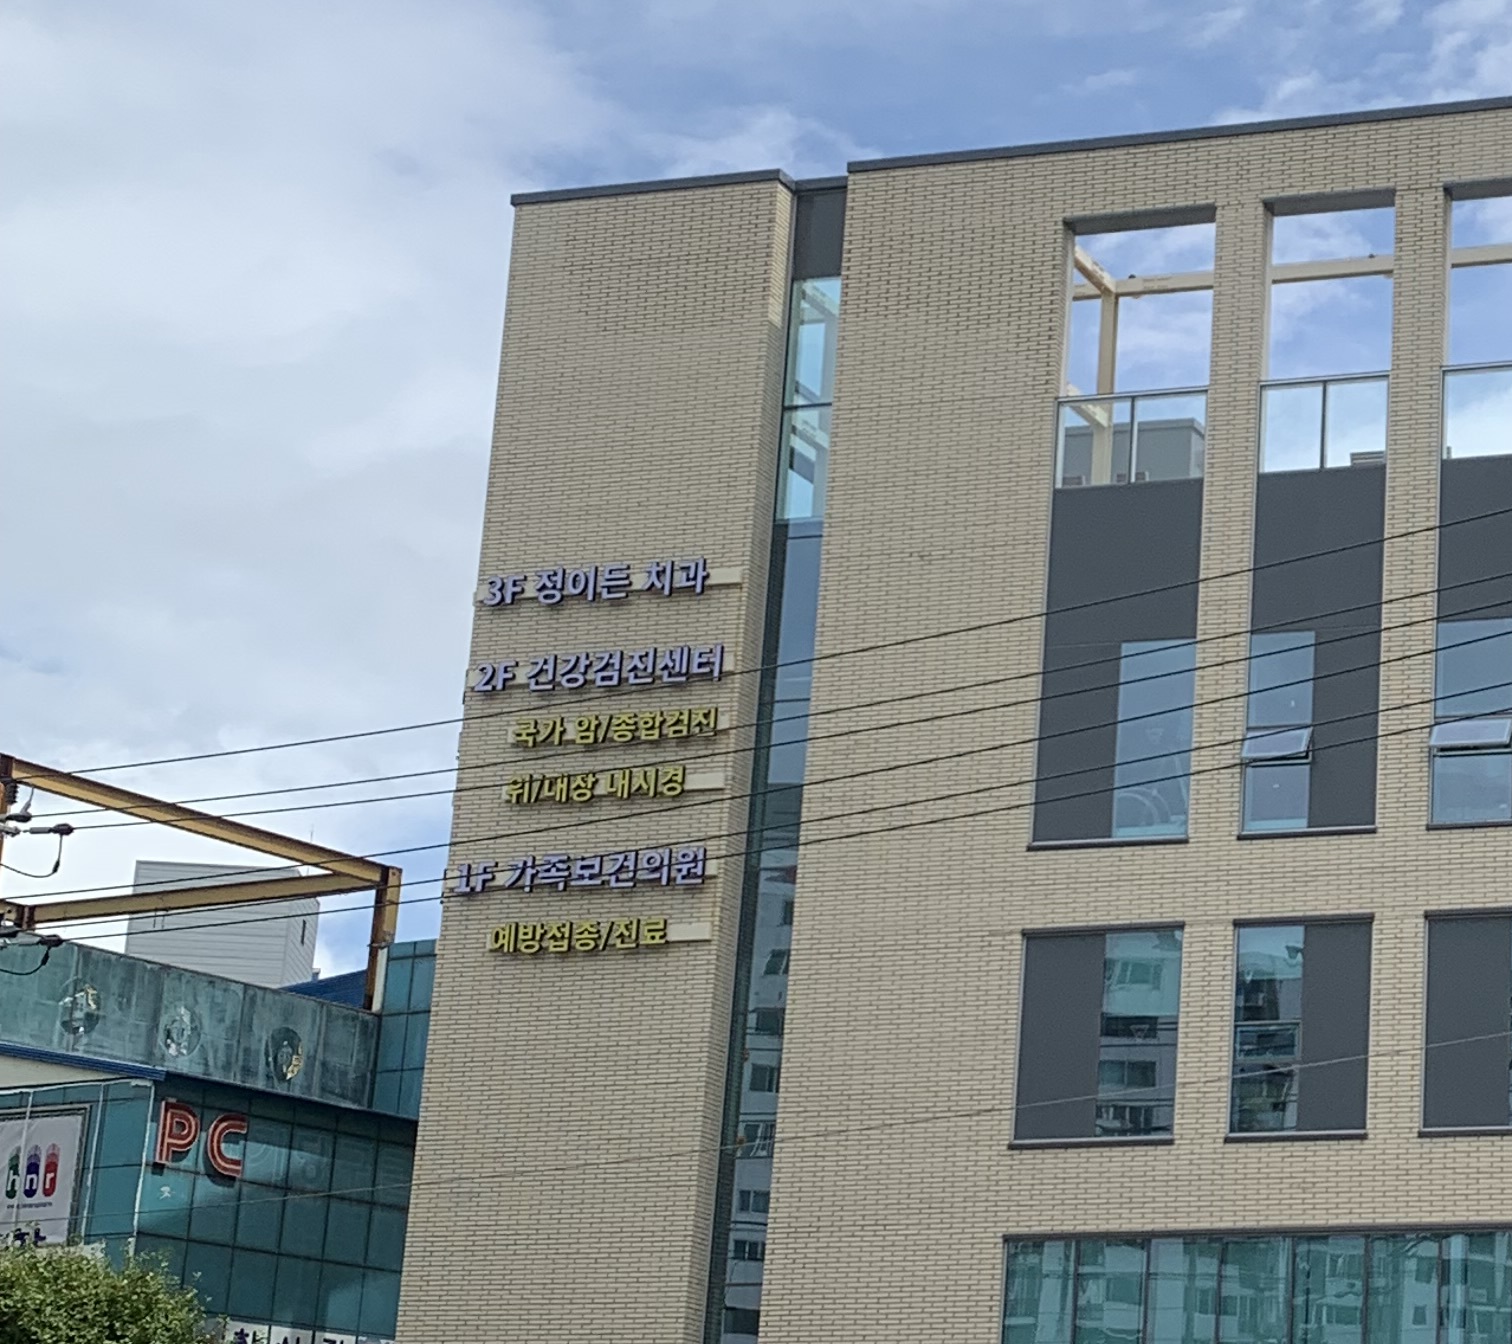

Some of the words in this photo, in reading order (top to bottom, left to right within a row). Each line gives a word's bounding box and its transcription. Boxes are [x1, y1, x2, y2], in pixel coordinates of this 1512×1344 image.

[483, 574, 527, 607] 3F
[533, 563, 631, 605] 정이든
[641, 556, 709, 596] 치과
[474, 660, 518, 693] 2F
[526, 643, 725, 692] 건강검진센터
[514, 717, 566, 748] 국가
[574, 707, 719, 745] 암/종합검진
[605, 764, 686, 799] 내시경
[453, 861, 498, 894] 1F
[504, 846, 707, 893] 가족보건의원
[490, 917, 668, 955] 예방접종/진료
[154, 1099, 249, 1178] PC
